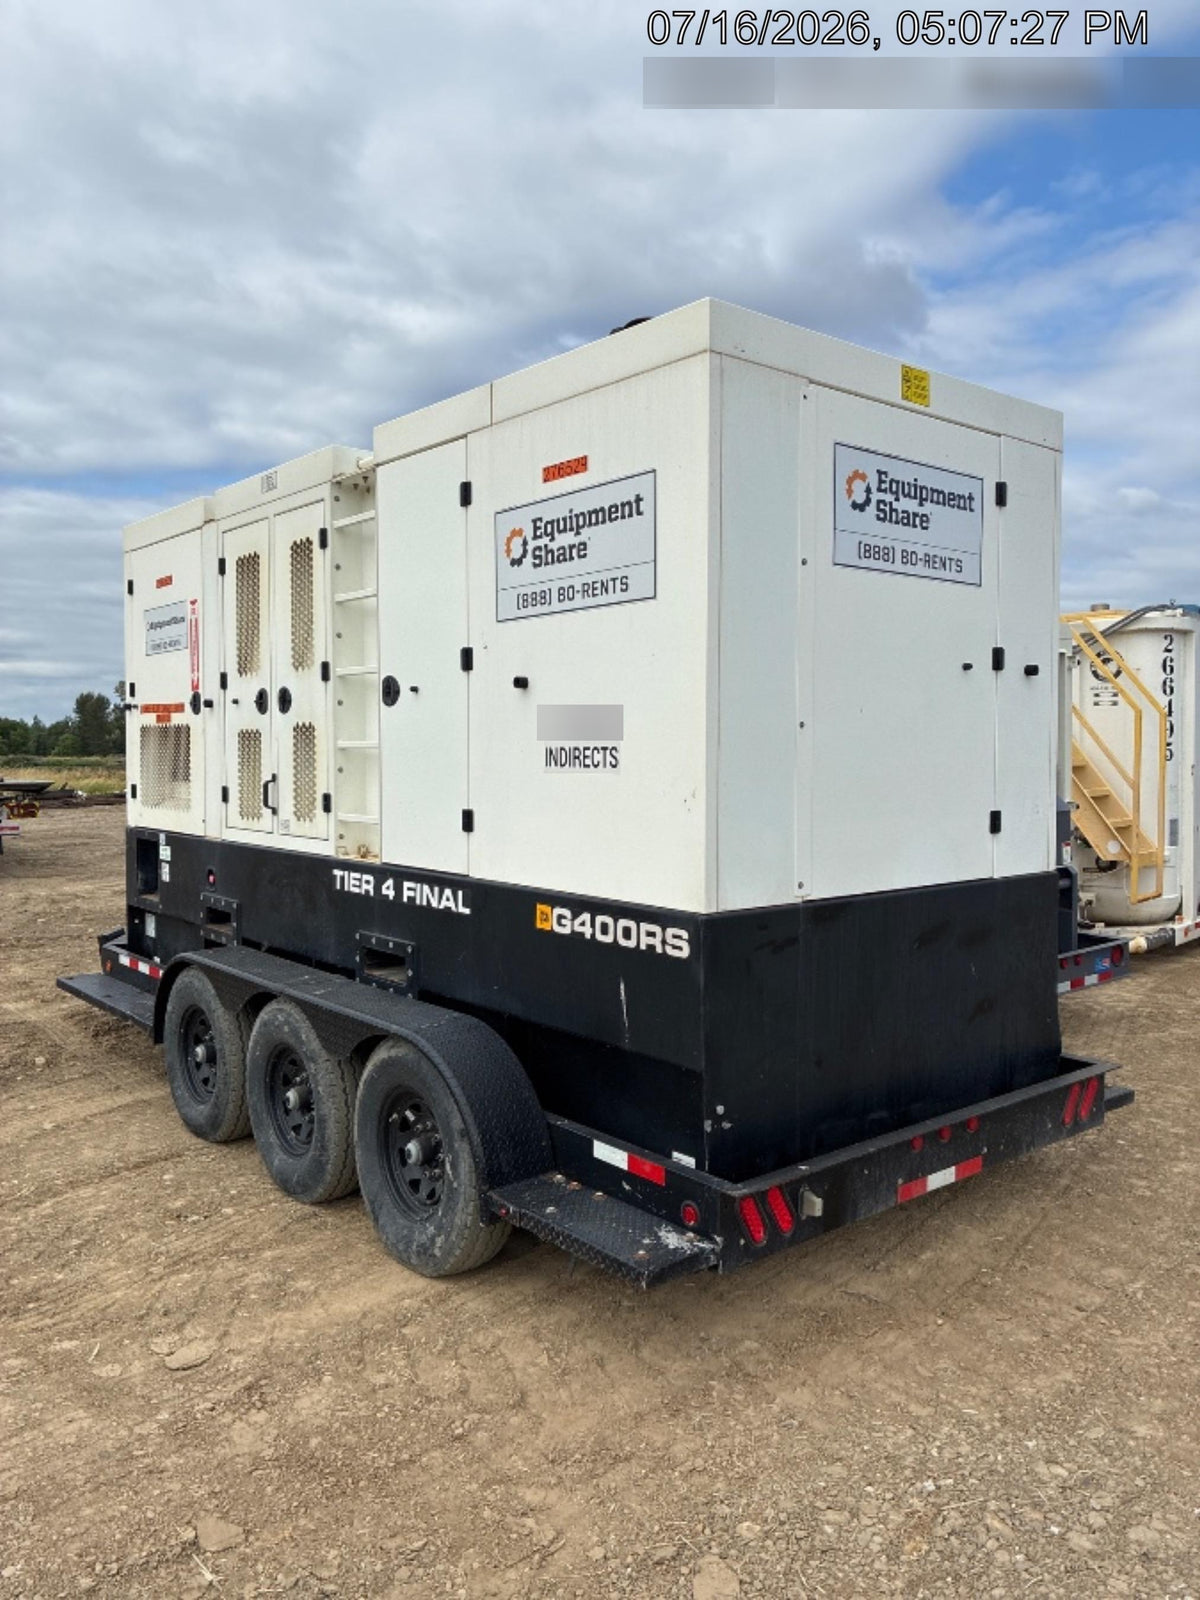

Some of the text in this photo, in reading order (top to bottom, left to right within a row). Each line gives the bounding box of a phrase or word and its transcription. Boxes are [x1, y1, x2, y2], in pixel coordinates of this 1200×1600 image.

[876, 468, 975, 513] Equipment
[531, 493, 645, 543] Equipment
[875, 498, 931, 531] Share
[531, 540, 588, 569] Share
[544, 745, 620, 769] INDIRECTS
[332, 868, 471, 915] TIER 4 FINAL
[551, 906, 691, 960] G400RS
